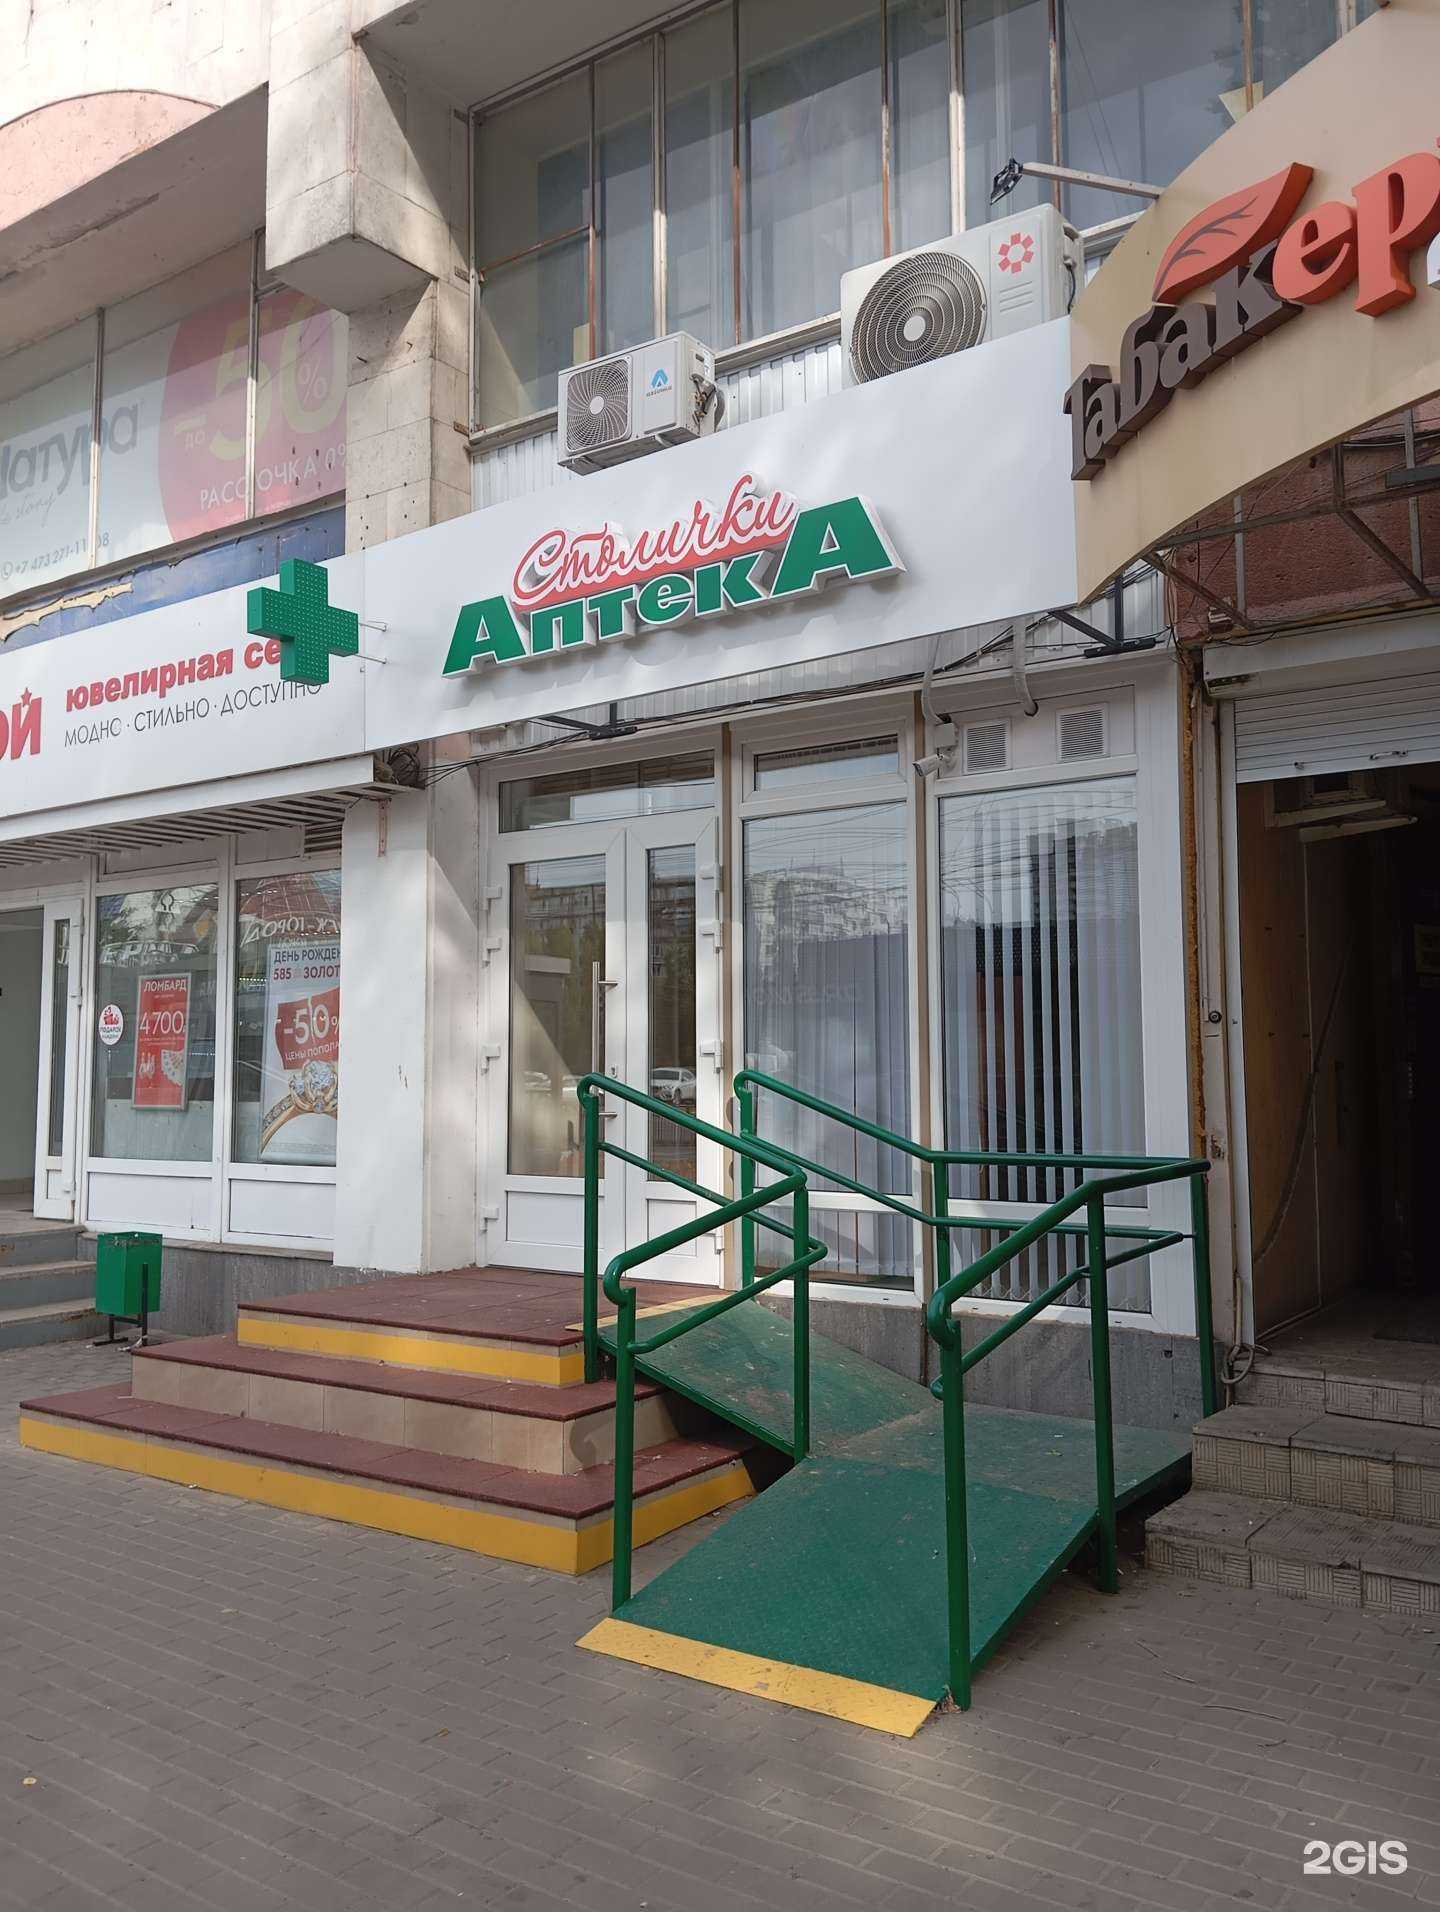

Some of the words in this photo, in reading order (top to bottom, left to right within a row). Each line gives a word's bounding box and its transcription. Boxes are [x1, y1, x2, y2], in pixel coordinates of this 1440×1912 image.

[201, 456, 317, 511] РАССОЧКА
[513, 473, 798, 601] Столички
[66, 649, 233, 712] ювелирная
[244, 638, 281, 669] се
[64, 718, 122, 748] МОДНО
[134, 698, 210, 732] СТИЛЬНО
[273, 968, 292, 980] 585
[274, 950, 300, 963] ДЕНЬ
[143, 980, 187, 992] ЛОМБАРД
[140, 1010, 184, 1035] 4700
